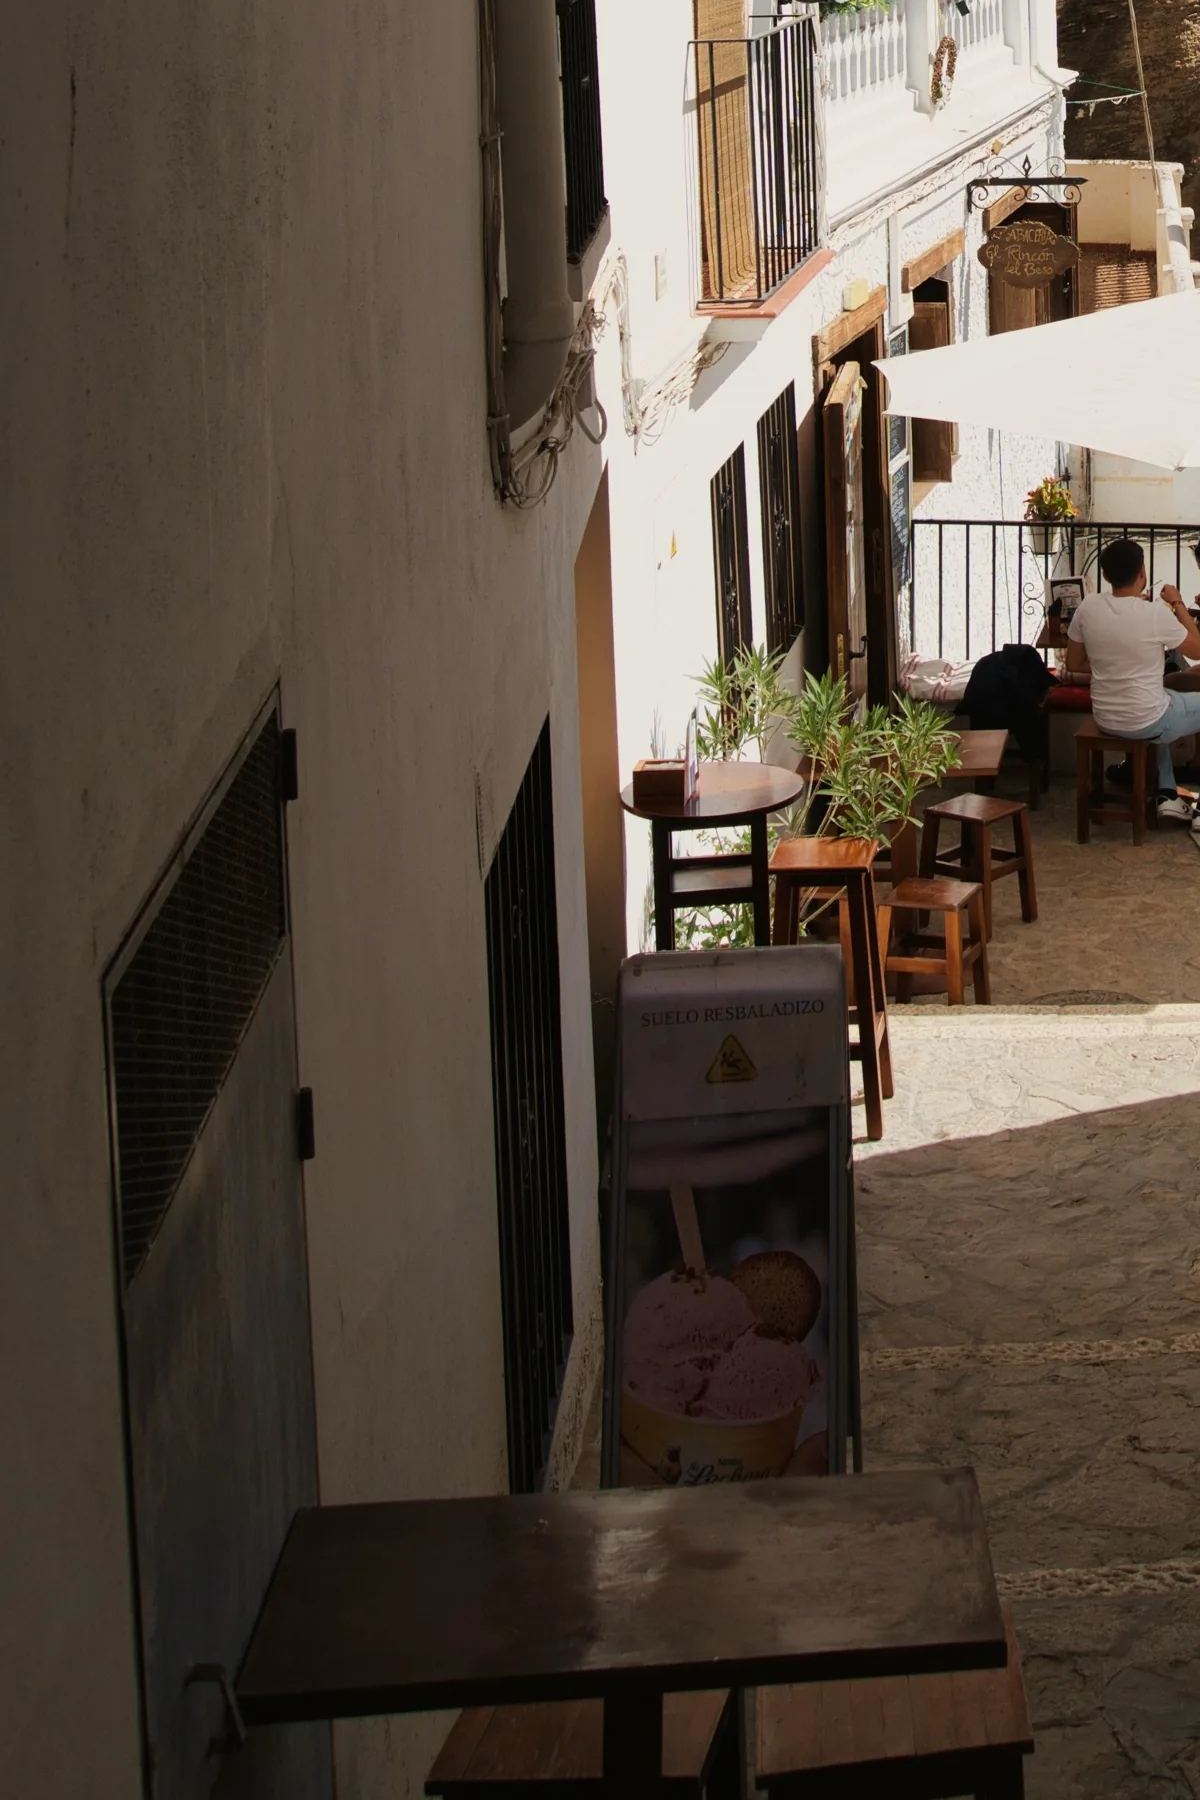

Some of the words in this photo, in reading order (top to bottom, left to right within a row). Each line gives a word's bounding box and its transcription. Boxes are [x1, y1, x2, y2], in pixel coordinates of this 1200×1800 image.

[985, 244, 1002, 263] El
[1005, 244, 1057, 263] Rincón
[1004, 261, 1022, 277] del
[1024, 261, 1054, 278] Beso
[641, 1008, 700, 1027] SUELO
[703, 999, 826, 1023] RESBALADIZO
